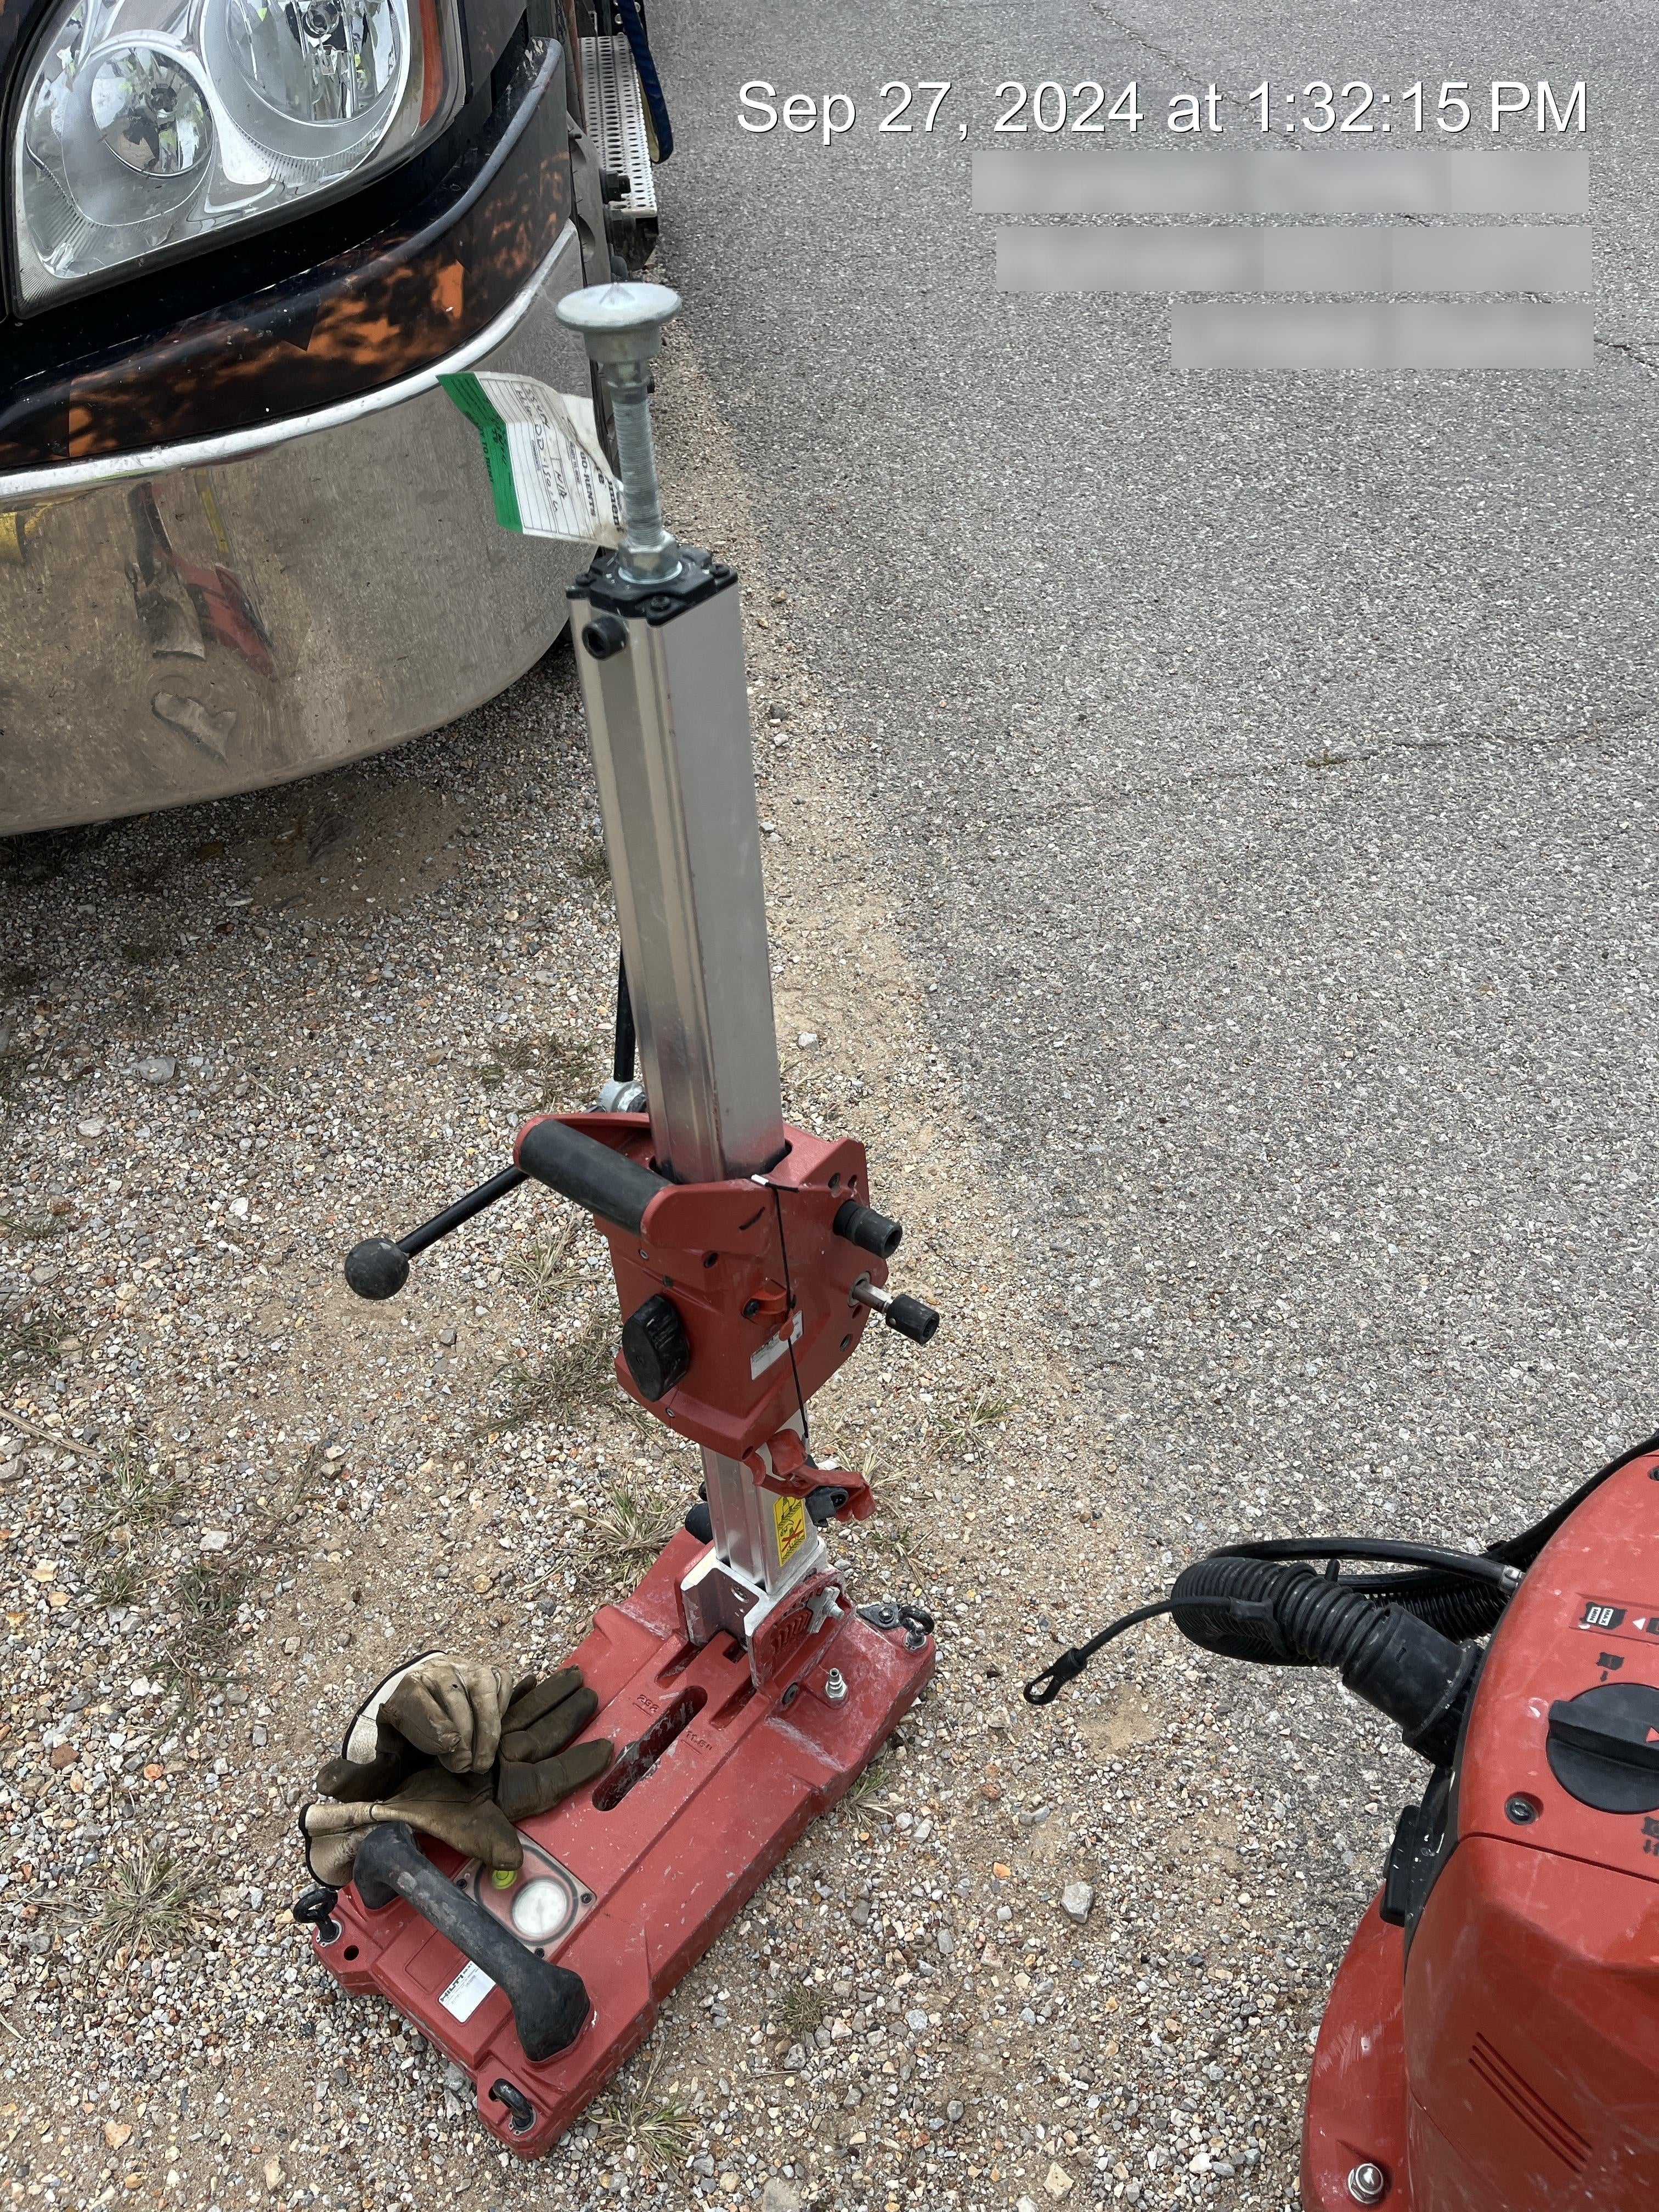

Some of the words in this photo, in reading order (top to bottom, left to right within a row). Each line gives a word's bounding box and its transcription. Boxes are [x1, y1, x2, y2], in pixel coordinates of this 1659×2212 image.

[1589, 1608, 1599, 1621] MIN
[1600, 1609, 1611, 1624] MAX
[439, 1974, 464, 2002] HILTI
